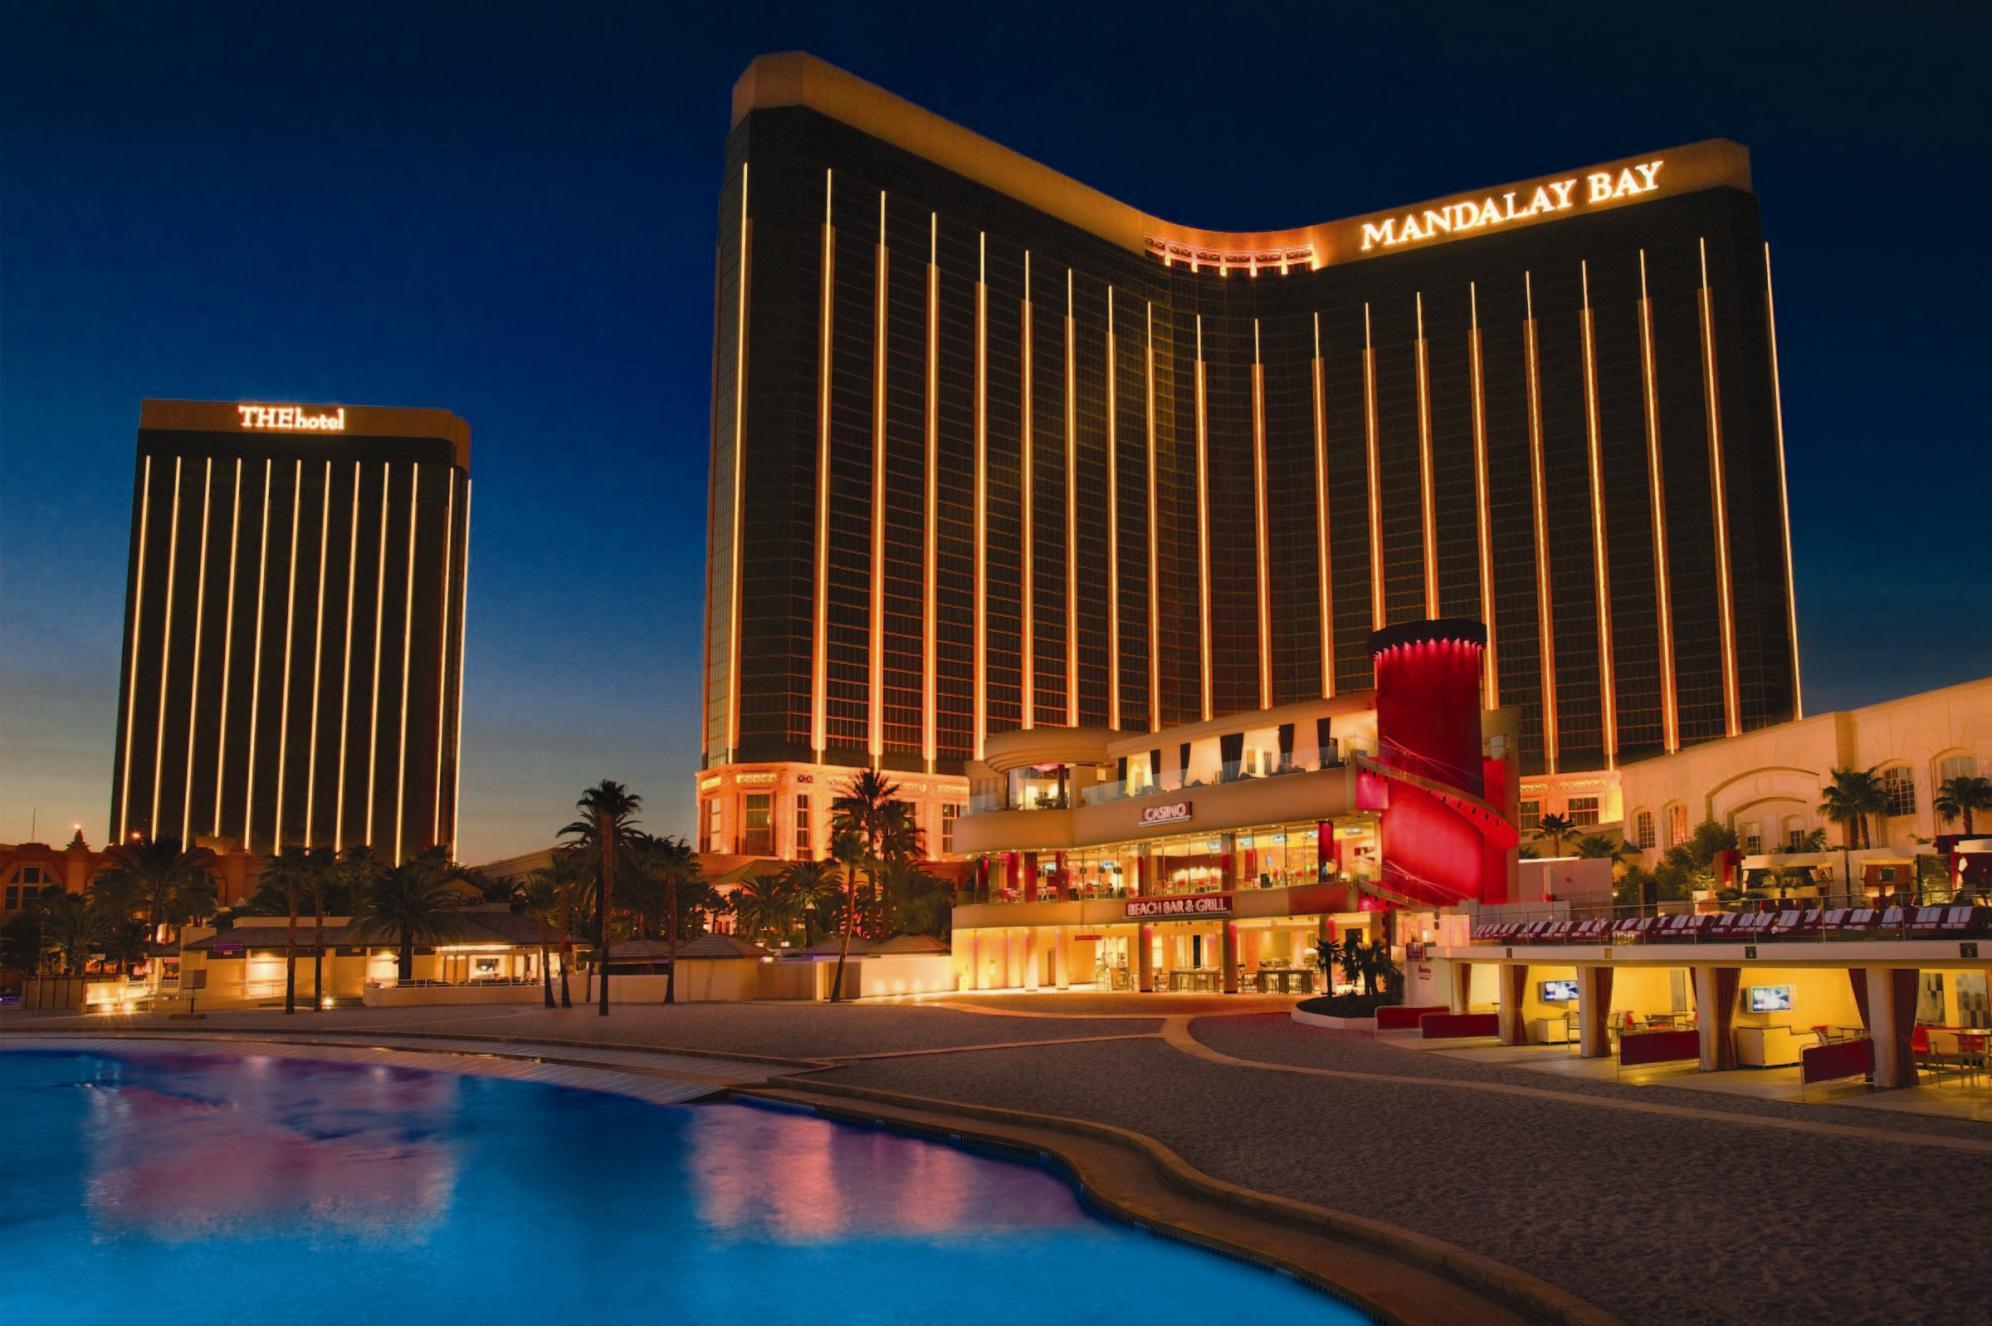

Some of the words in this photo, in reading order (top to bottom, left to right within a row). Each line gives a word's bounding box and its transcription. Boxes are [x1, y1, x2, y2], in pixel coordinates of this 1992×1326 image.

[1361, 179, 1577, 251] MANDALAY
[1587, 160, 1664, 204] BAY
[238, 405, 345, 431] THEhotel
[1145, 803, 1186, 821] CASINO
[1127, 902, 1161, 916] BEACH
[1163, 899, 1184, 914] BAR
[1185, 899, 1194, 912] &
[1197, 898, 1227, 912] GRILL
